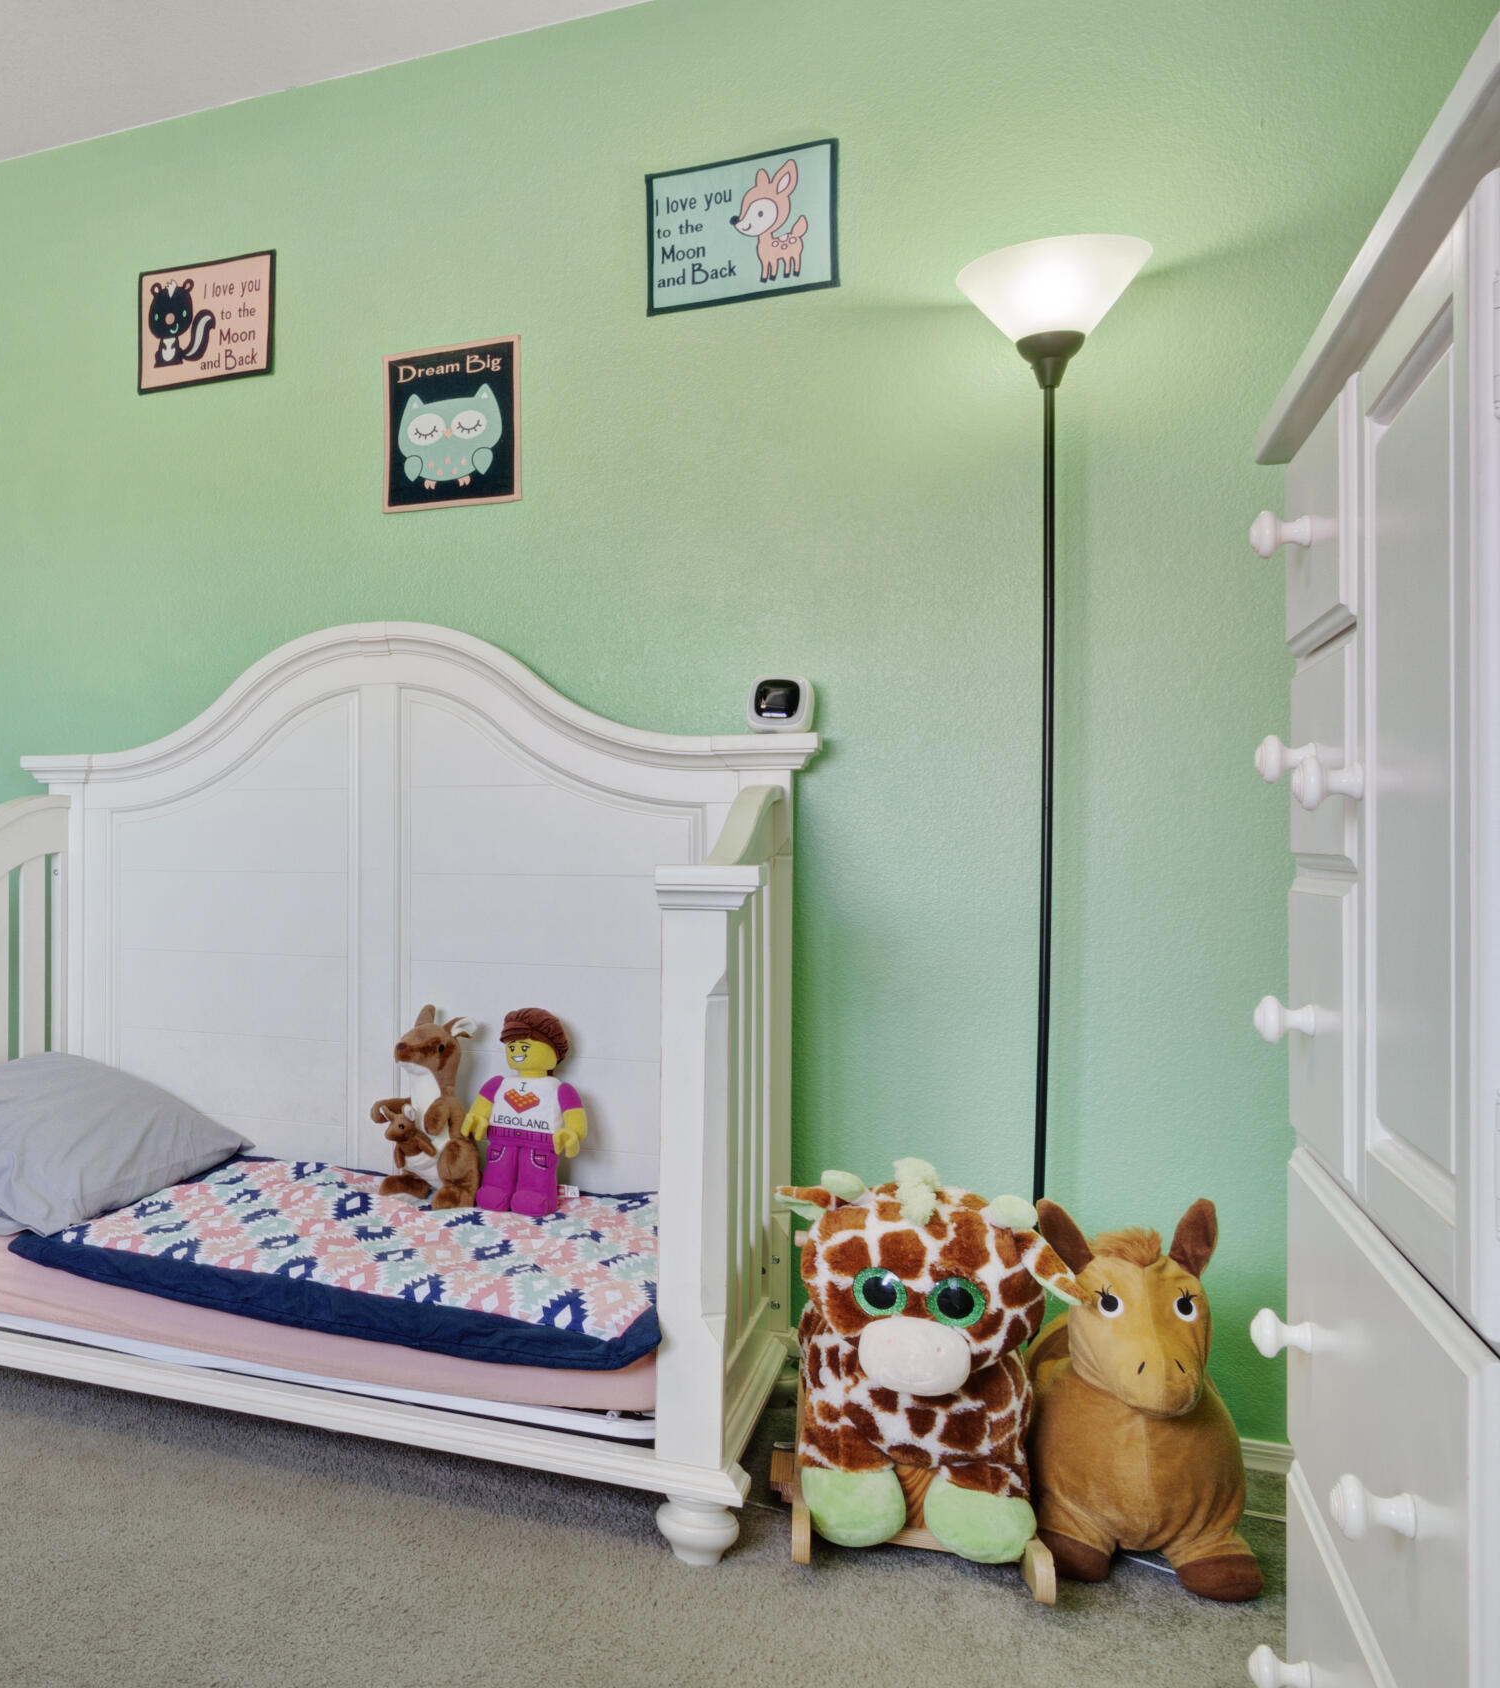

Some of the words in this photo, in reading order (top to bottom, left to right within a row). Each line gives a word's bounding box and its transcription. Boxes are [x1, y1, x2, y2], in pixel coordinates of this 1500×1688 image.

[666, 196, 697, 215] love
[704, 189, 732, 211] you
[657, 227, 671, 239] to
[678, 219, 703, 235] the
[661, 245, 706, 264] Moon
[657, 268, 686, 288] and
[691, 260, 737, 285] Back
[212, 281, 234, 297] love
[240, 279, 261, 297] you
[220, 309, 232, 320] to
[237, 302, 256, 318] the
[219, 328, 256, 345] Moon
[200, 353, 221, 370] and
[224, 348, 257, 370] Back
[397, 361, 460, 383] Dream
[466, 354, 502, 374] Big
[519, 1082, 527, 1092] I
[493, 1113, 550, 1130] LEGOLAND
